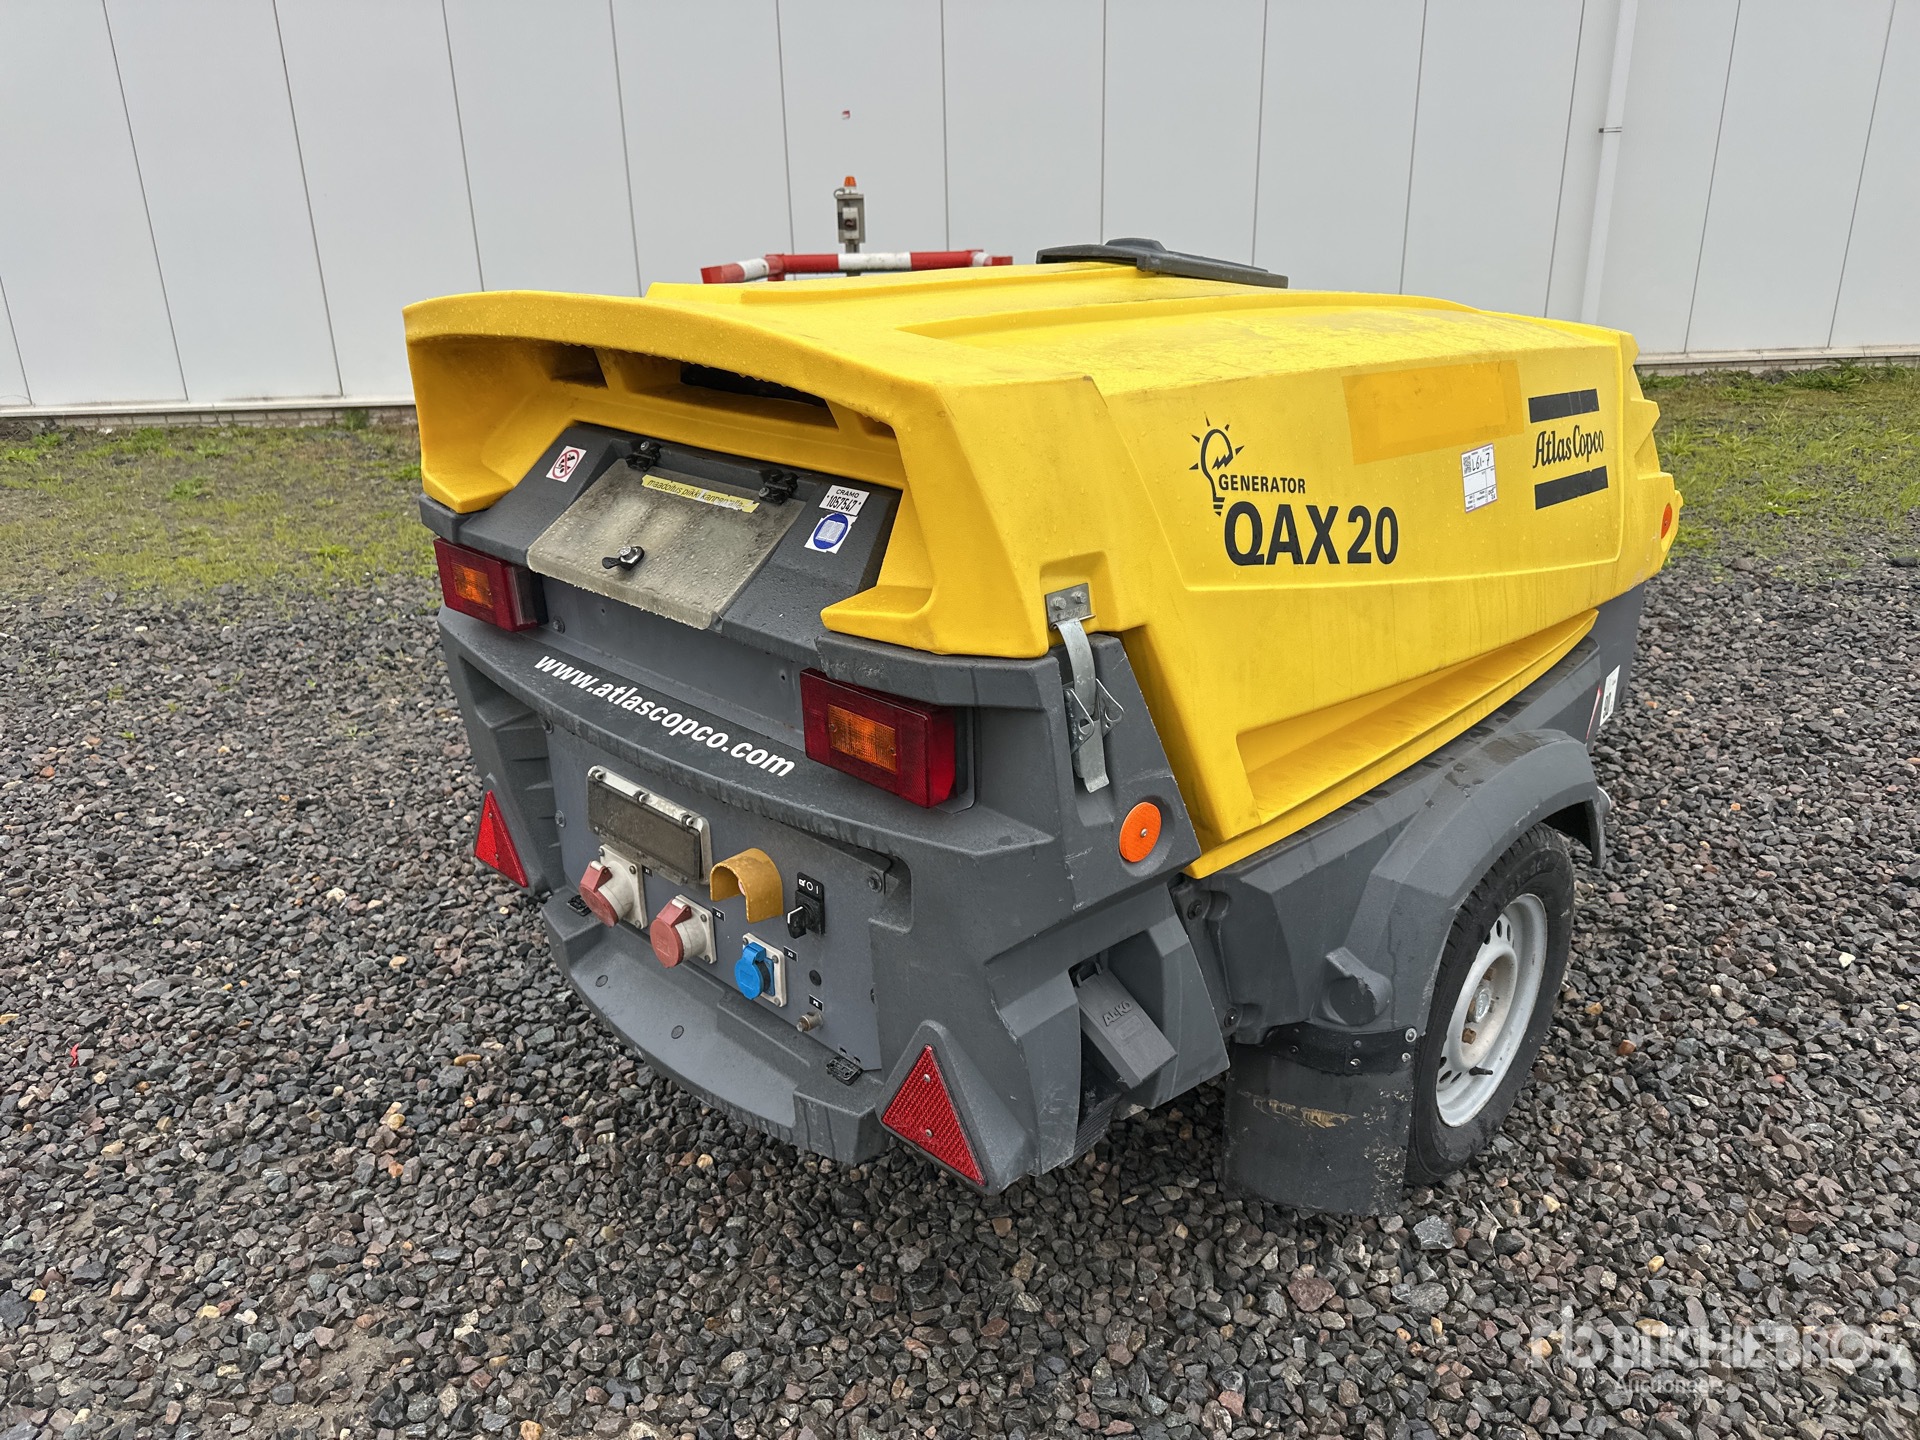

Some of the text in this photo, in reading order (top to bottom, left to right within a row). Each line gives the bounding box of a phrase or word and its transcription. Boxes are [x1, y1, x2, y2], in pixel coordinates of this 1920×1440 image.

[1532, 424, 1604, 469] Atlas Copco
[646, 479, 682, 493] maadoitus
[836, 488, 860, 499] CRAMO
[1218, 473, 1306, 493] GENERATOR
[1224, 501, 1399, 567] QAX20
[534, 655, 796, 778] www.atlascopco.com
